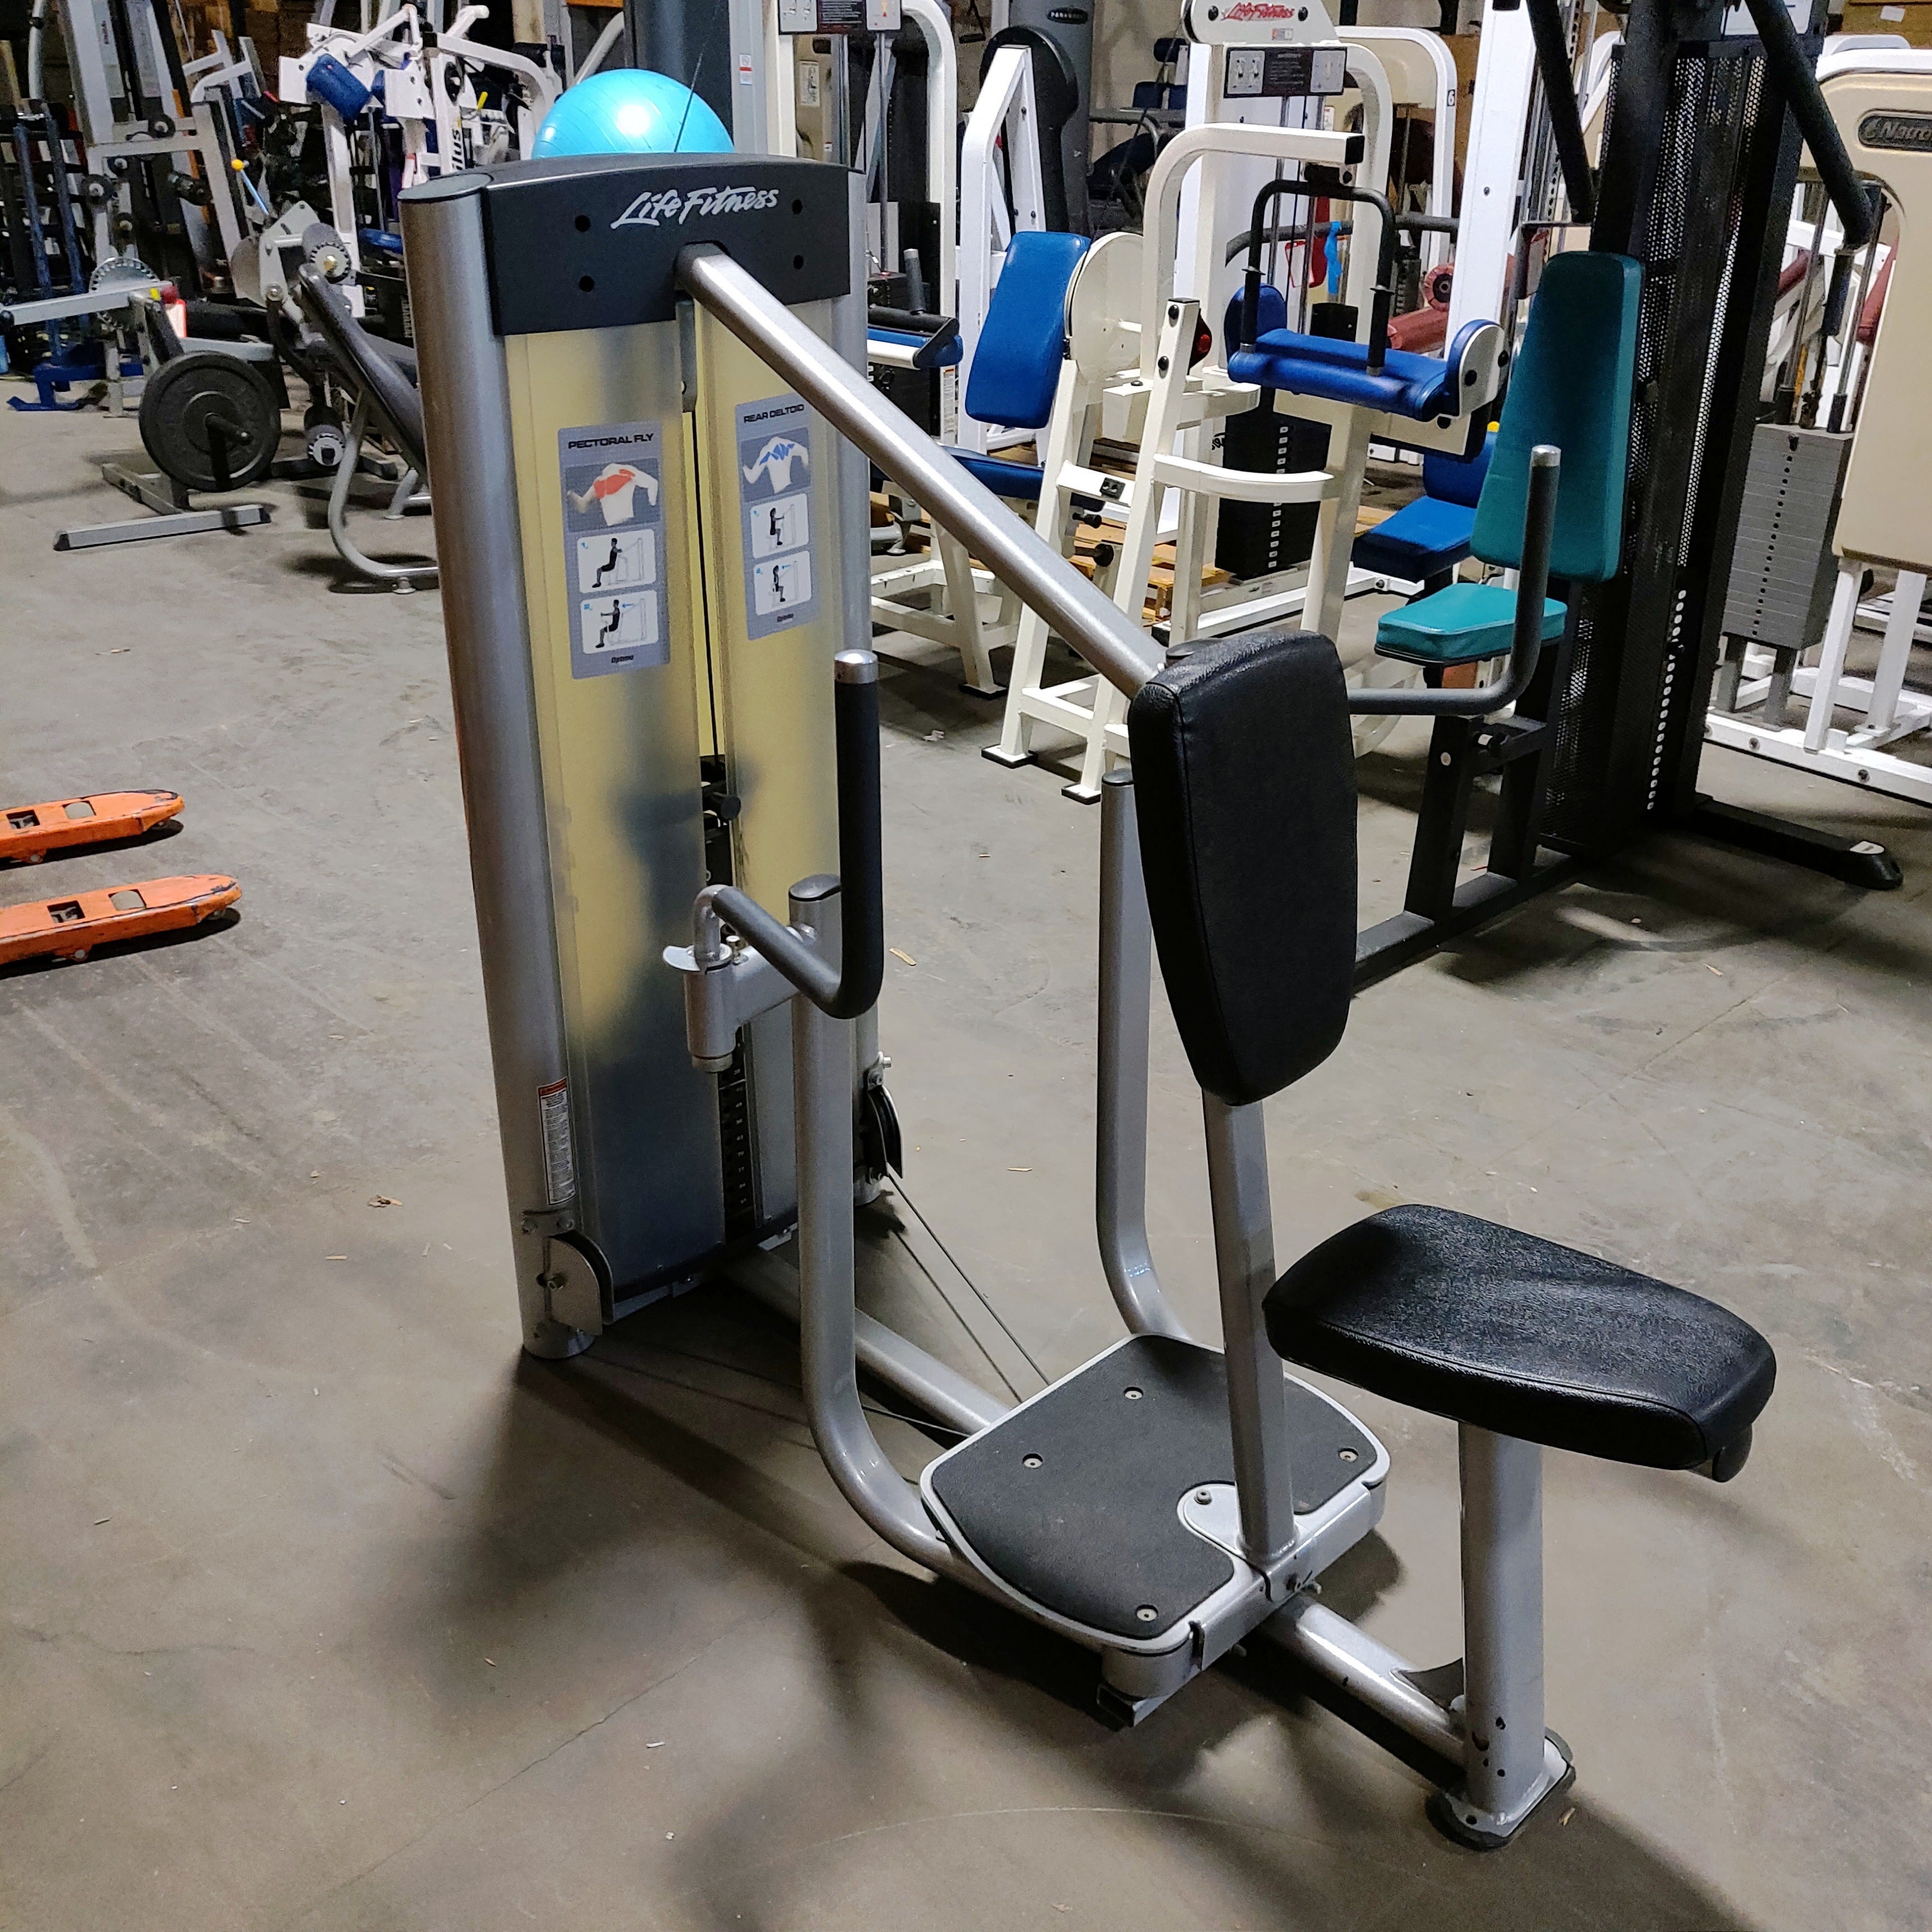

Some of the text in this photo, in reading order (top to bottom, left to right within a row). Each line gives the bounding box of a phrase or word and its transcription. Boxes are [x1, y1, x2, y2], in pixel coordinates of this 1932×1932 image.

[1448, 90, 1455, 106] 6
[610, 186, 779, 229] Life Fitness
[744, 404, 805, 423] REAR DELTOID
[568, 433, 654, 449] PECTORAL FLY
